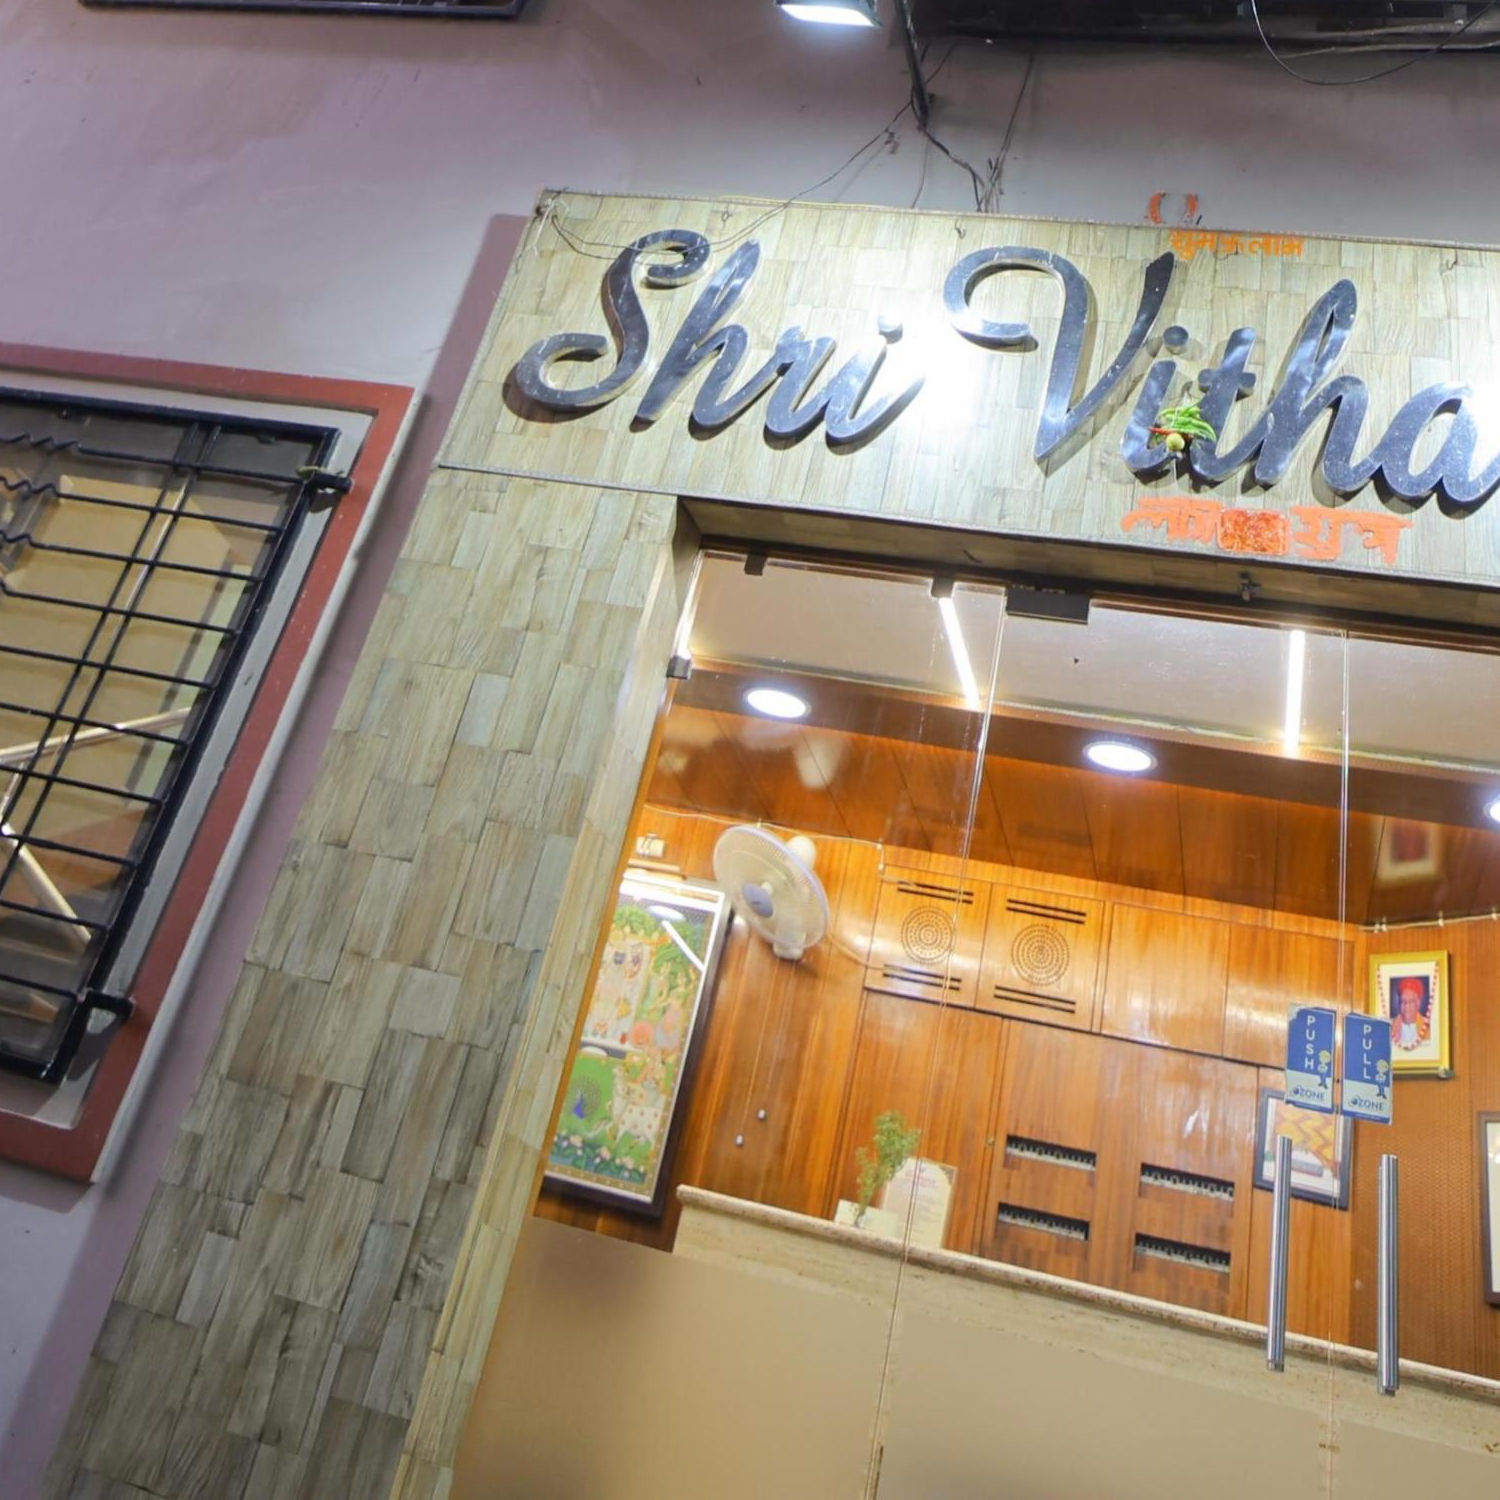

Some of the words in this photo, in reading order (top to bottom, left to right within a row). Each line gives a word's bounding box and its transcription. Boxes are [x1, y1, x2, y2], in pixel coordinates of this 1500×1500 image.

[514, 228, 925, 446] Shri
[1304, 1015, 1316, 1070] PUSH
[1362, 1024, 1373, 1080] PULL
